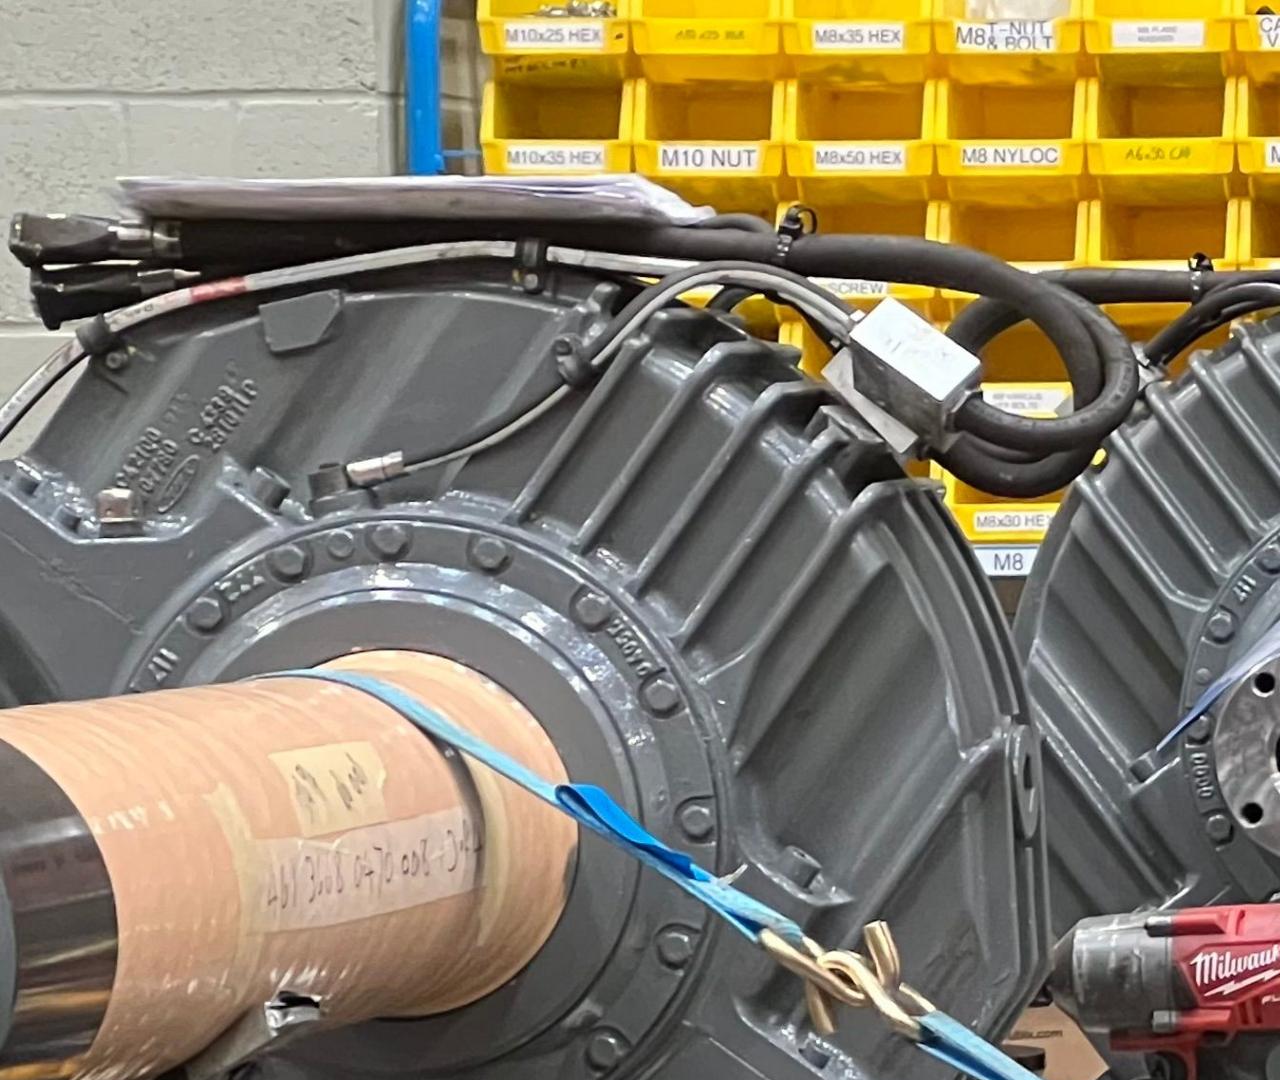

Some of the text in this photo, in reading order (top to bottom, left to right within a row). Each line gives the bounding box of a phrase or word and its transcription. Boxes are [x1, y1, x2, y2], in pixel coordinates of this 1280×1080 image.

[505, 28, 601, 43] M10x25 HEX
[815, 29, 901, 43] M8x35 HEX
[956, 26, 986, 46] M8
[986, 21, 1047, 36] T-NUT
[986, 35, 1053, 50] & BOLT
[507, 150, 602, 166] M10x35 HEX
[661, 149, 757, 168] M10 NUT
[815, 150, 902, 165] M8x50 HEX
[962, 147, 1059, 164] M8 NYLOC
[1024, 514, 1053, 527] HE
[994, 553, 1024, 571] M8
